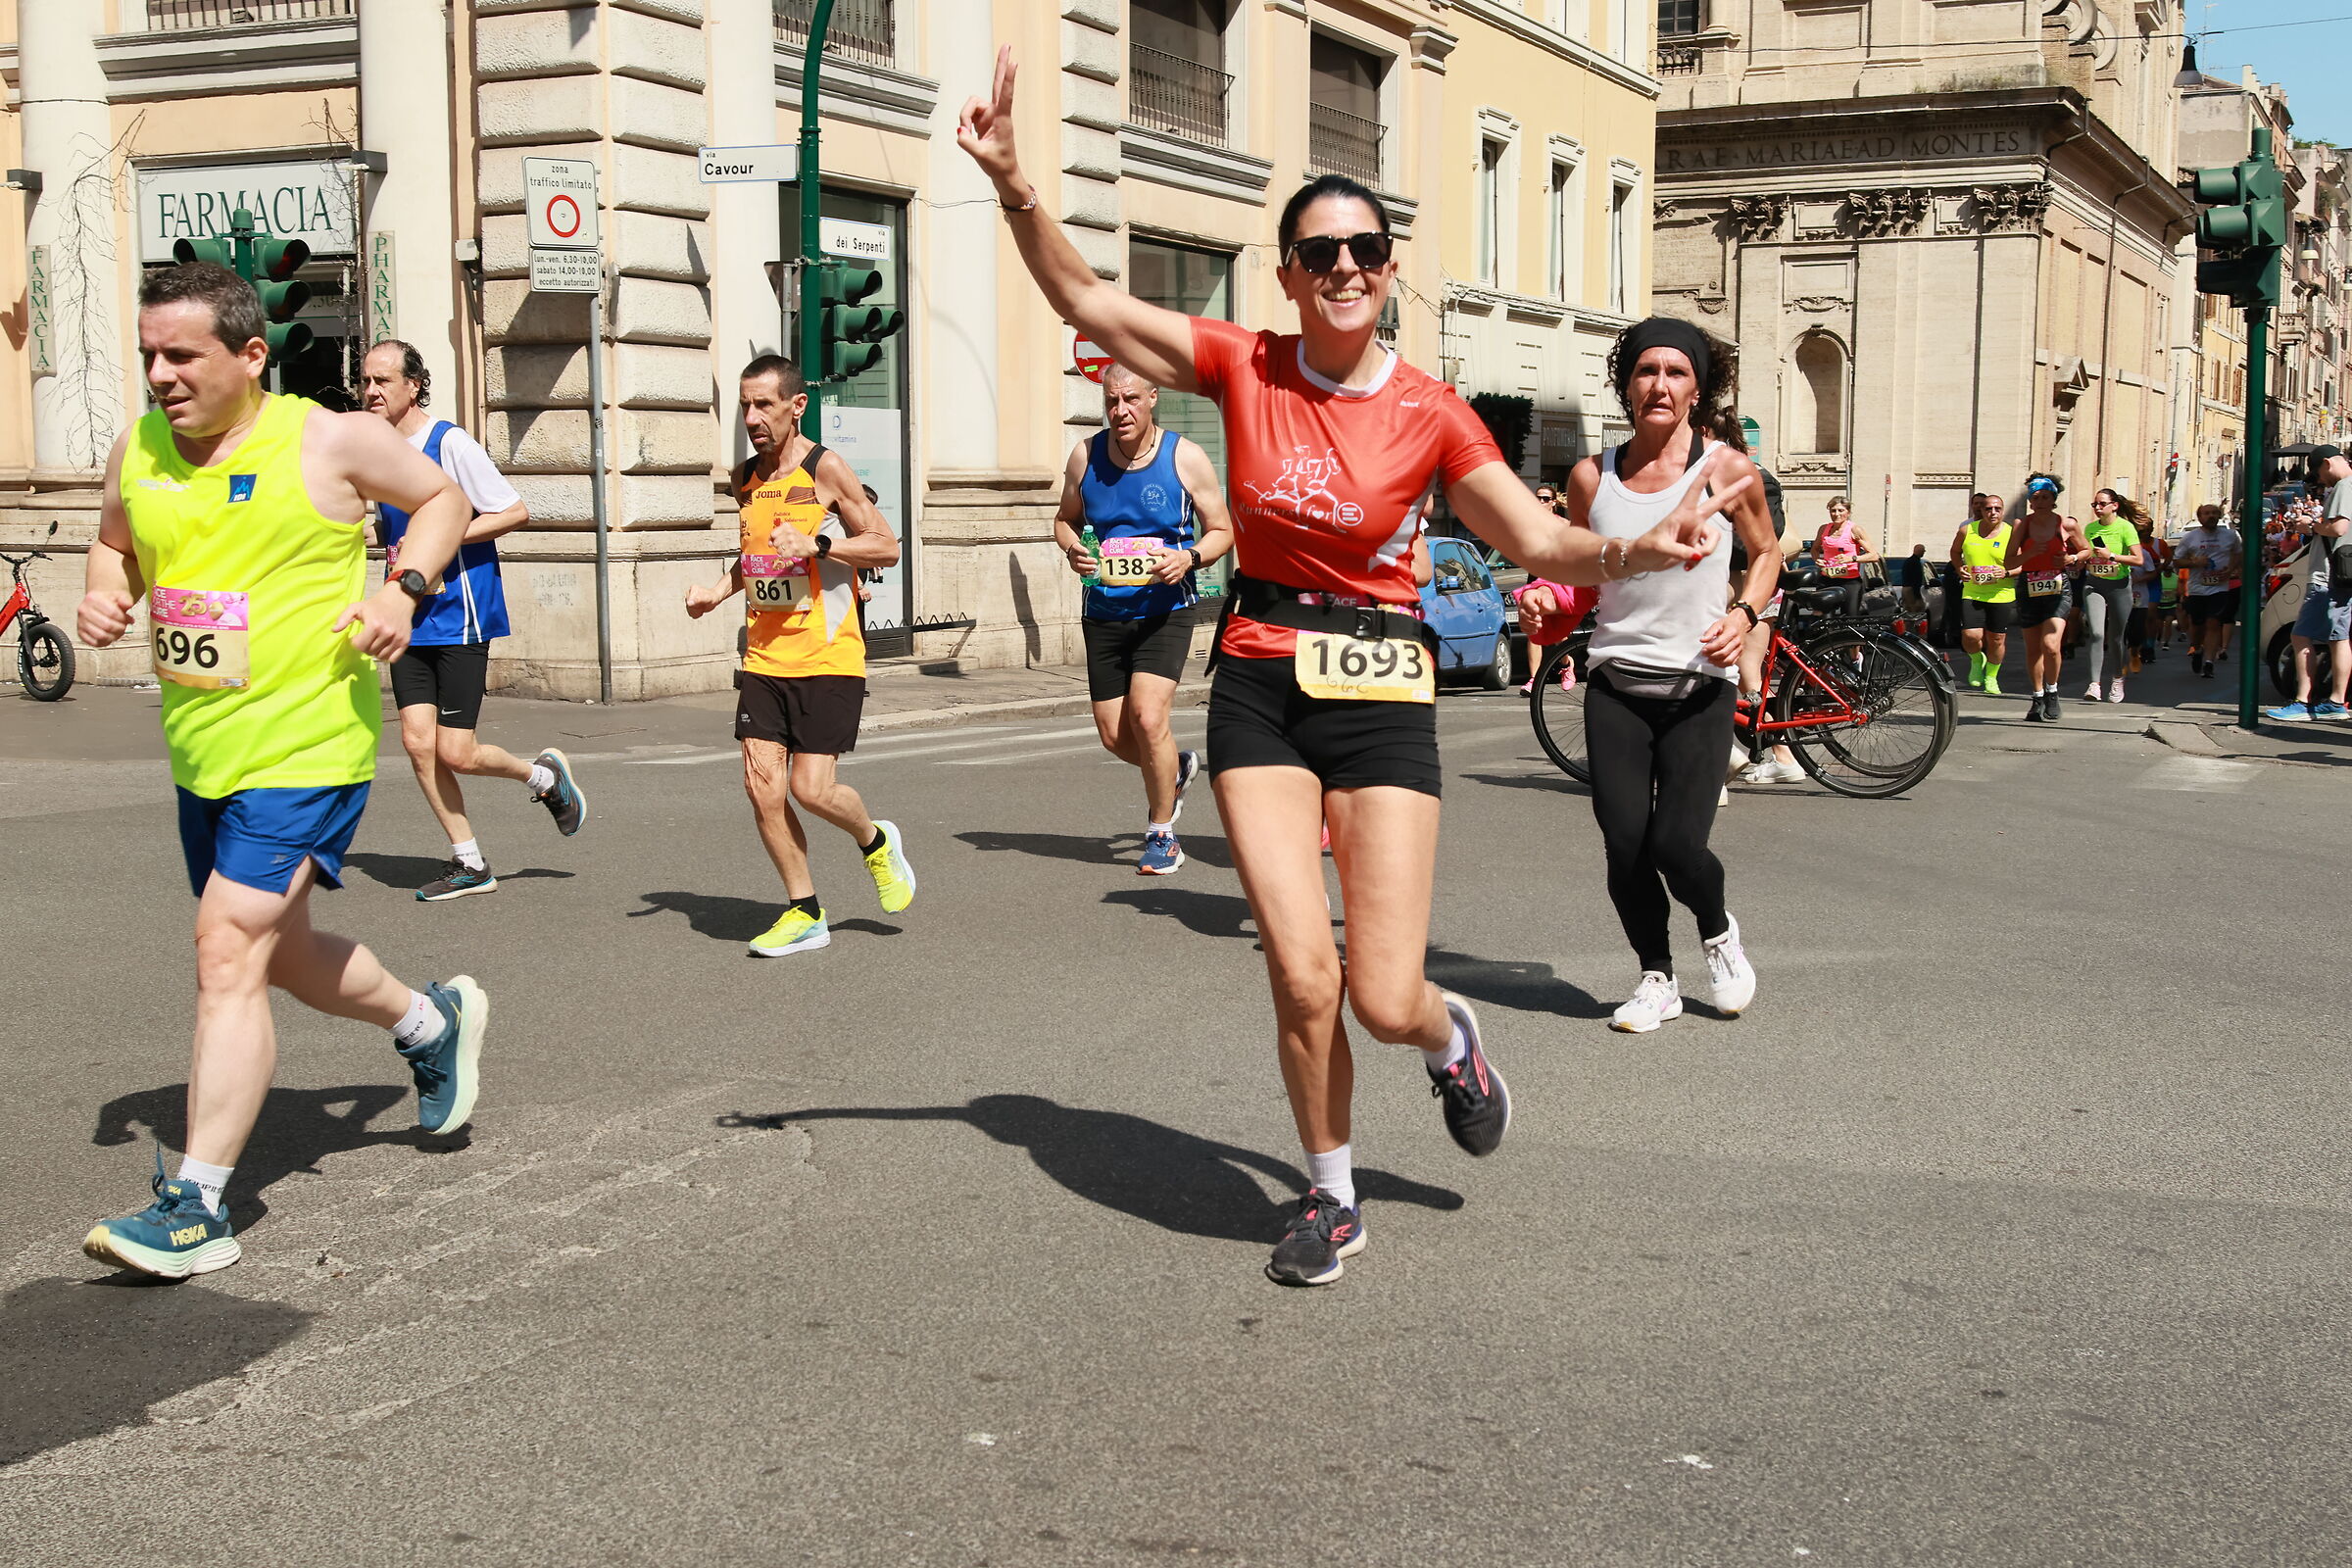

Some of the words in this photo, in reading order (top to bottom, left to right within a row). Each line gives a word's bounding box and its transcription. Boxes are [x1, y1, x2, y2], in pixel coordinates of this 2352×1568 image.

[1666, 146, 1728, 171] RAE
[1745, 139, 1852, 165] MARIAE
[1856, 137, 1895, 160] AD
[1910, 129, 2021, 157] MONTES
[552, 166, 569, 174] zona
[705, 163, 755, 175] Cavour
[529, 176, 560, 188] traffico
[562, 179, 592, 190] limitato
[157, 183, 334, 239] FARMACIA
[836, 235, 849, 250] dei
[853, 238, 886, 254] Serpenti
[536, 266, 557, 275] sabato
[372, 237, 393, 343] PHARMAC
[539, 277, 562, 286] eccetto
[564, 277, 595, 287] autorizzati
[30, 250, 50, 368] FARMACIA
[1975, 573, 1992, 582] 698
[2092, 564, 2115, 574] 1851
[755, 579, 793, 602] 861
[1332, 597, 1358, 607] ACE
[156, 627, 219, 669] 696
[1312, 639, 1424, 680] 1693
[170, 1224, 208, 1247] HOKA
